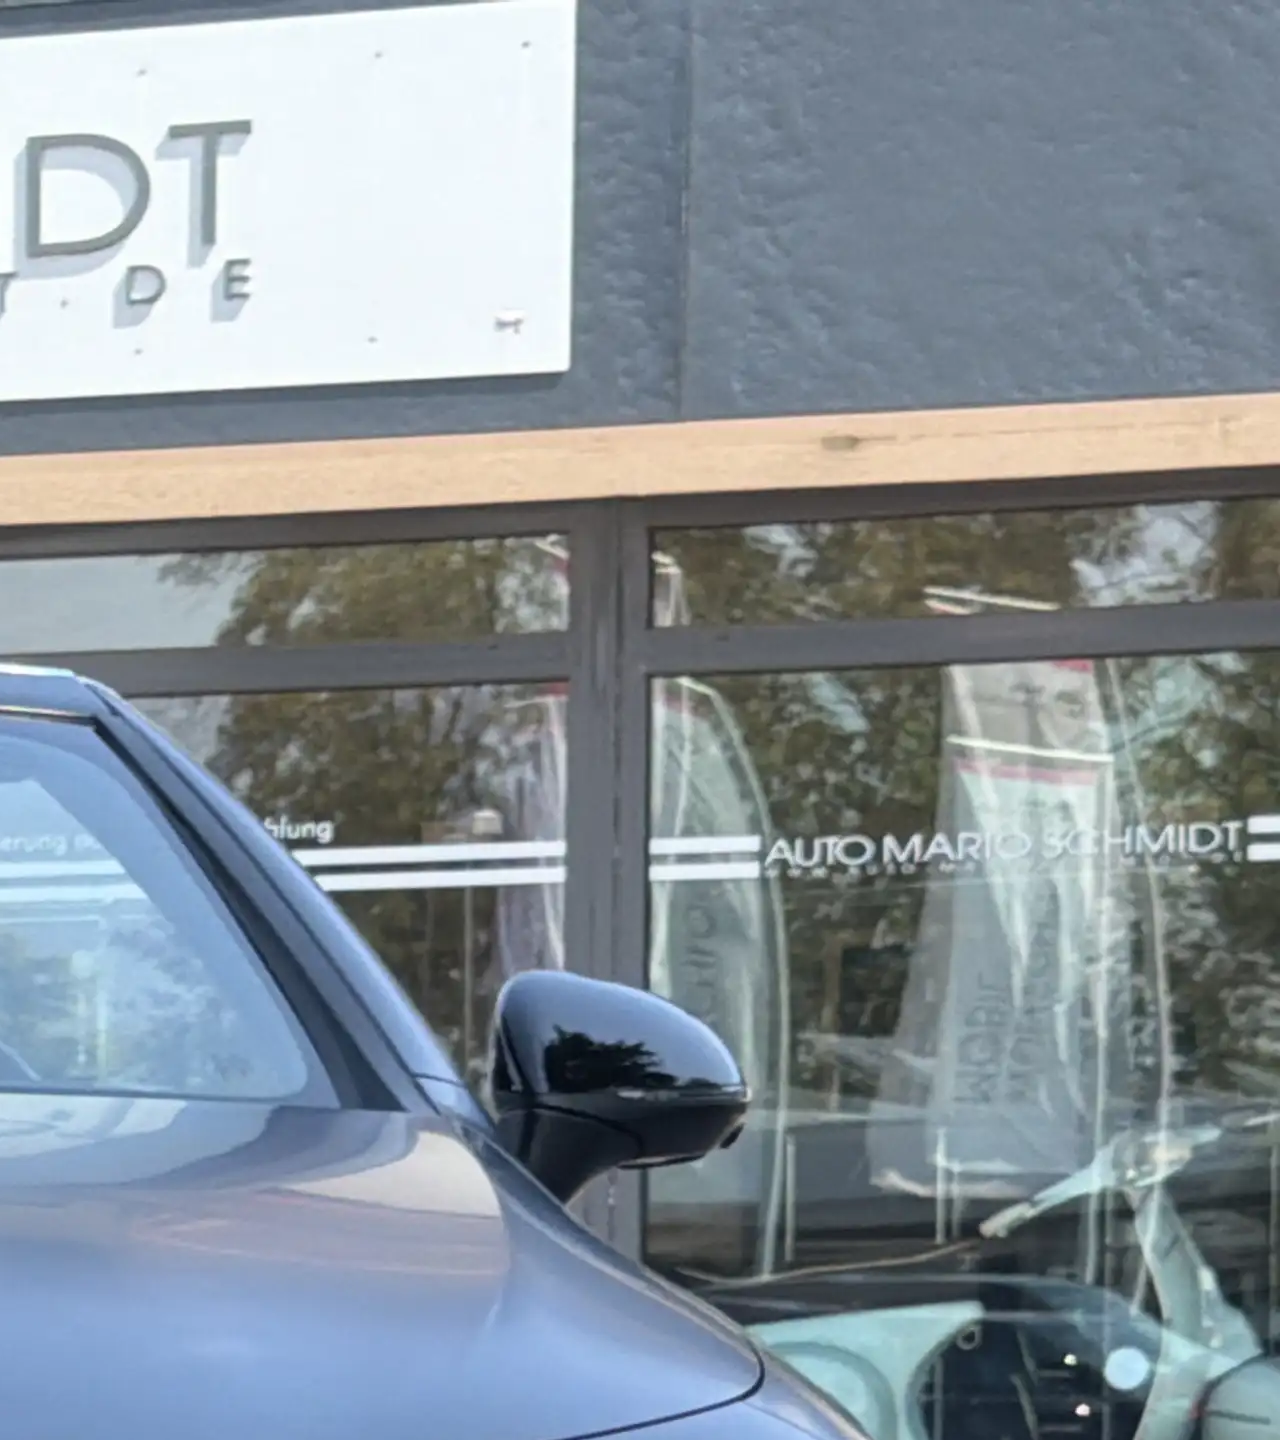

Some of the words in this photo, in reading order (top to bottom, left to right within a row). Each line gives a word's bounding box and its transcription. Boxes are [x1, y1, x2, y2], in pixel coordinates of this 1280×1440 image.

[765, 834, 877, 867] AUTO
[882, 830, 1033, 863] MARIO
[1045, 820, 1244, 858] SCHMIDT
